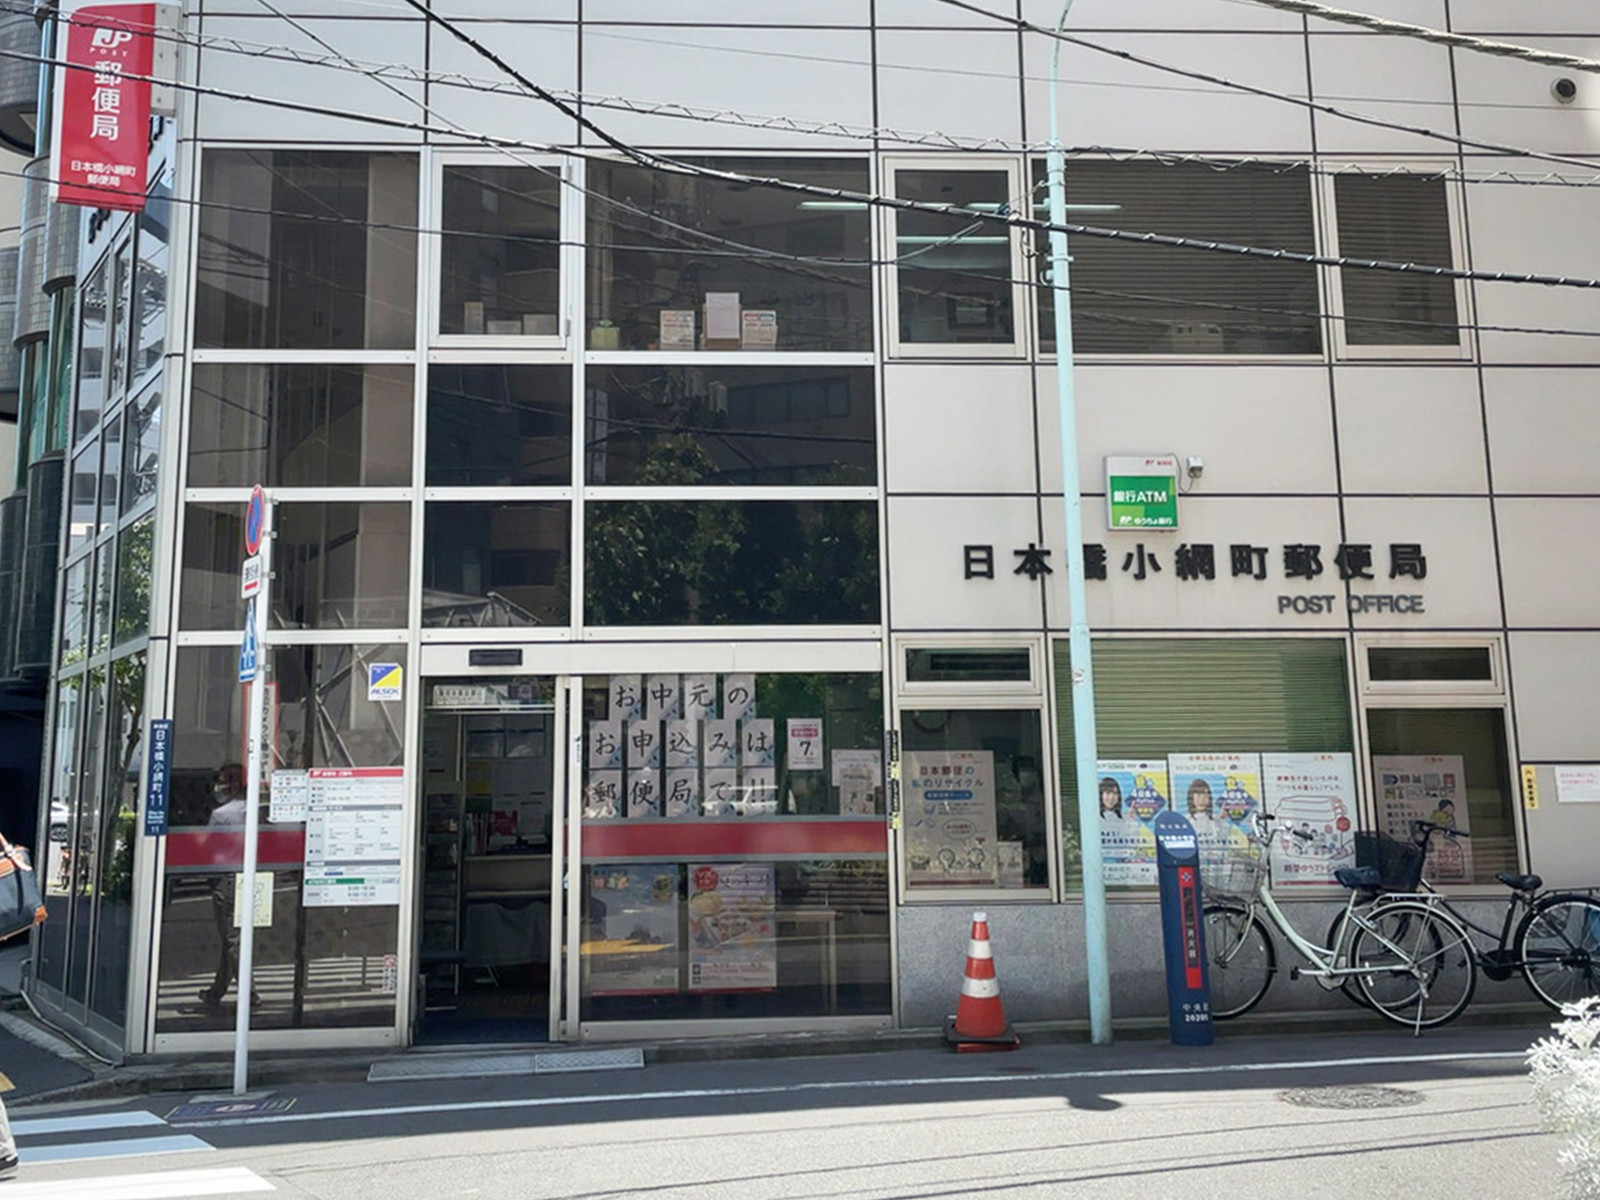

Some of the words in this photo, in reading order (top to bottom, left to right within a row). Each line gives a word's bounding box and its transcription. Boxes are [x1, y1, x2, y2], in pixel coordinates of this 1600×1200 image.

[90, 60, 122, 141] 郵便局
[71, 160, 137, 177] 日本橋小網町
[1278, 595, 1335, 614] POST
[1347, 595, 1425, 614] OFFICE
[614, 683, 750, 709] お中元の
[594, 729, 769, 757] お申込みは
